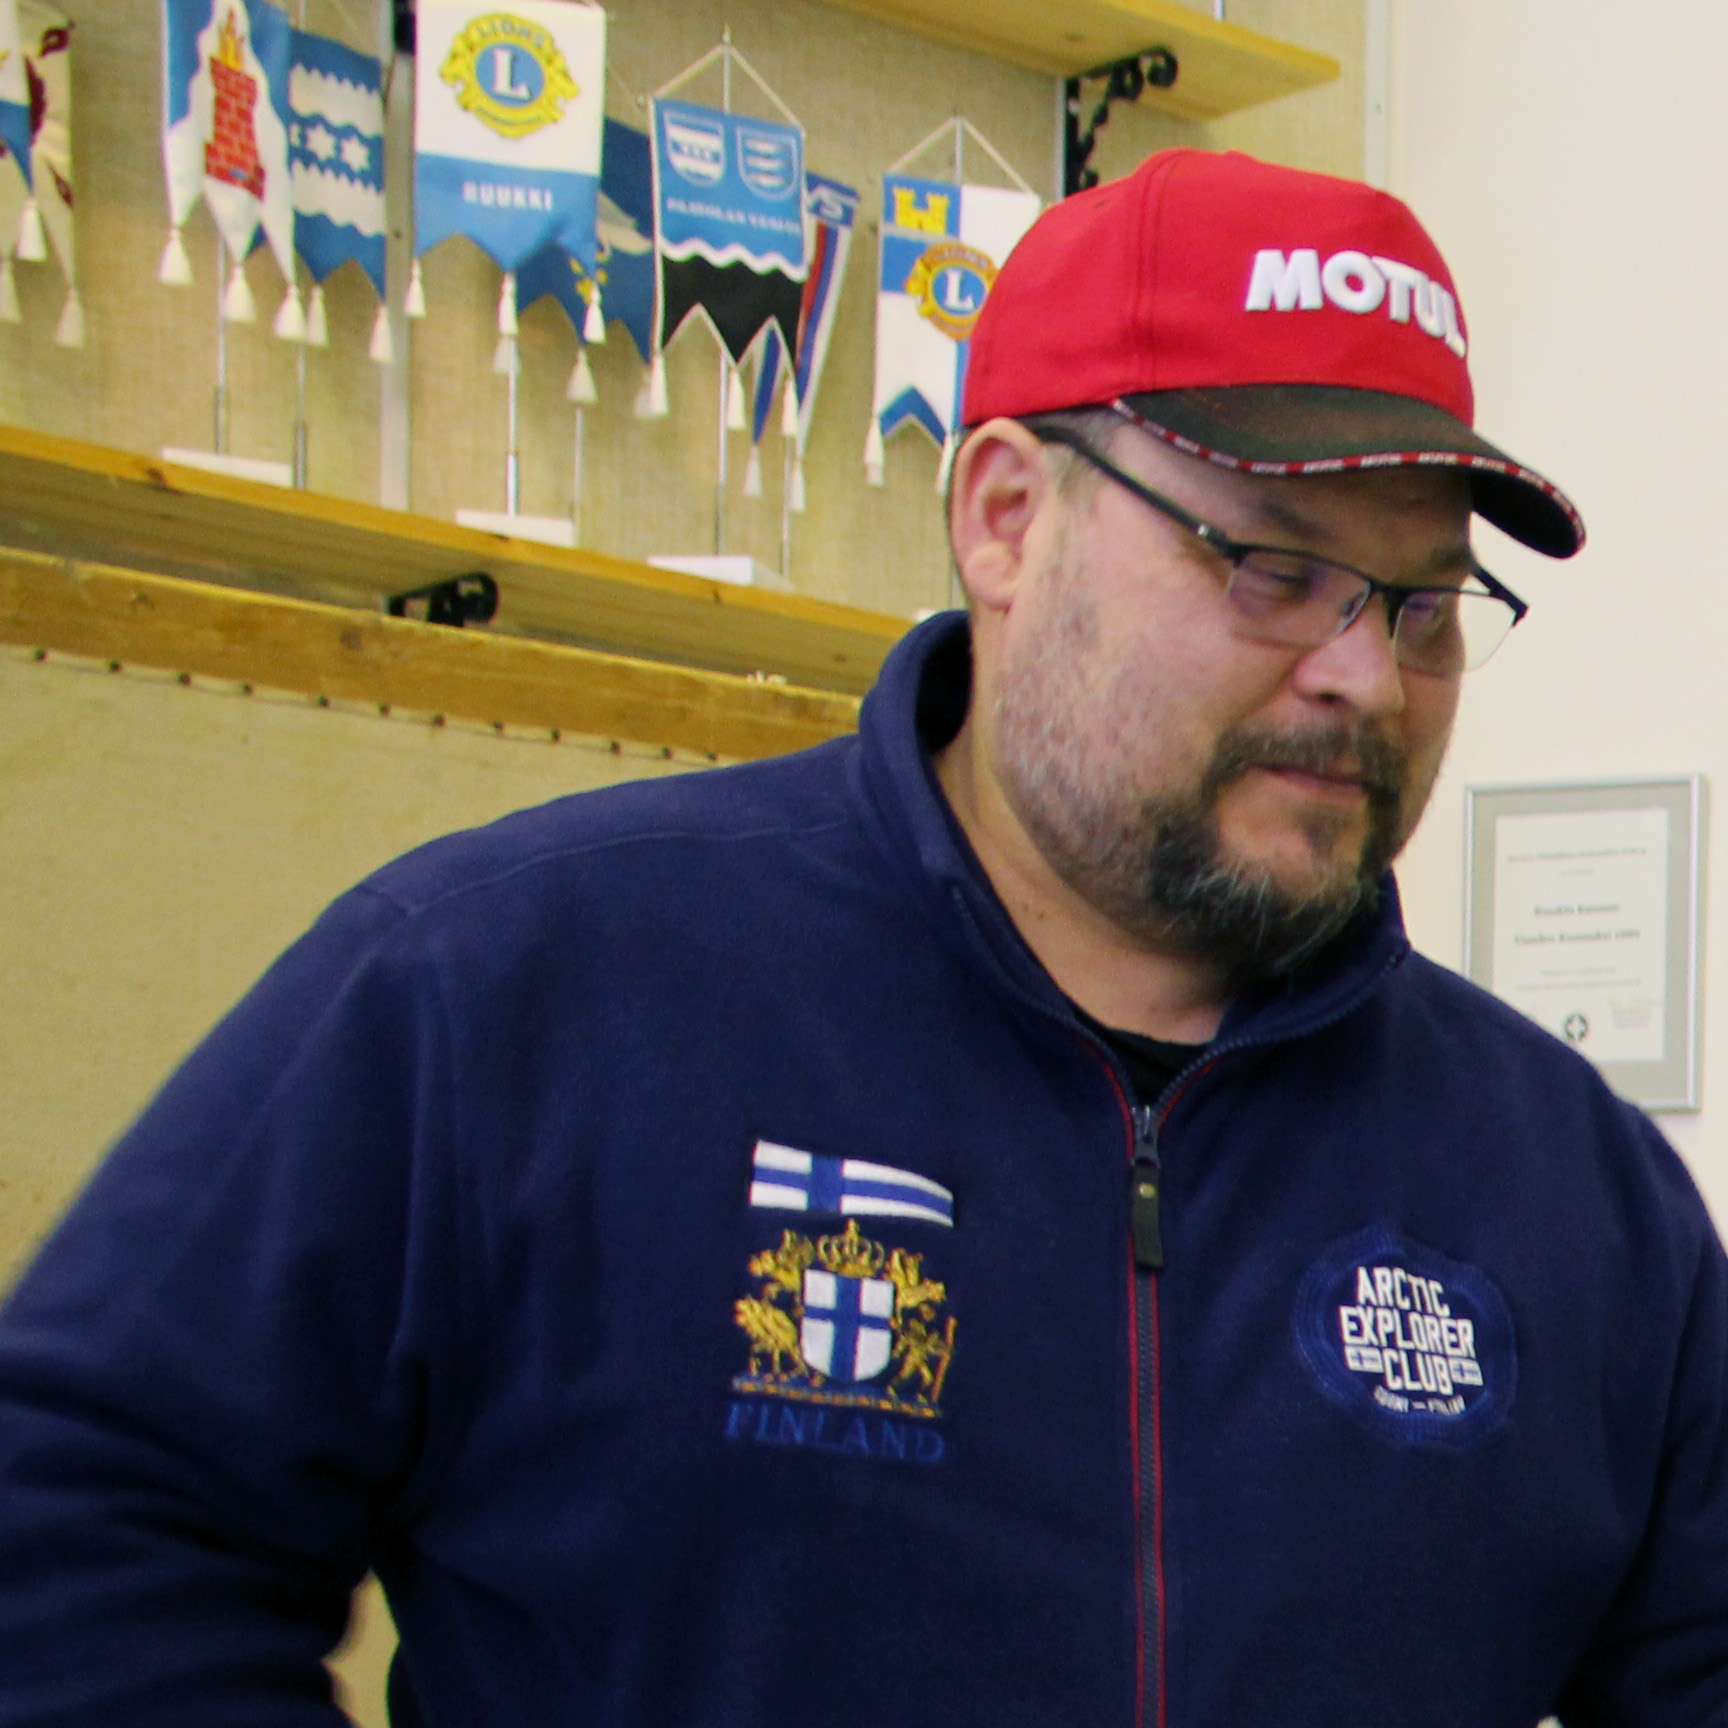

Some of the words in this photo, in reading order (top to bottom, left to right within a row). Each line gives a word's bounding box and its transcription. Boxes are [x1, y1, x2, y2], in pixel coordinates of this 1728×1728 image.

[493, 48, 531, 100] L
[944, 268, 975, 311] L
[1245, 248, 1467, 358] MOTUL
[1357, 1266, 1450, 1317] ARCTIC
[1338, 1305, 1476, 1358] EXPLORER
[1382, 1349, 1453, 1395] CLUB
[724, 1402, 945, 1463] FINLAND
